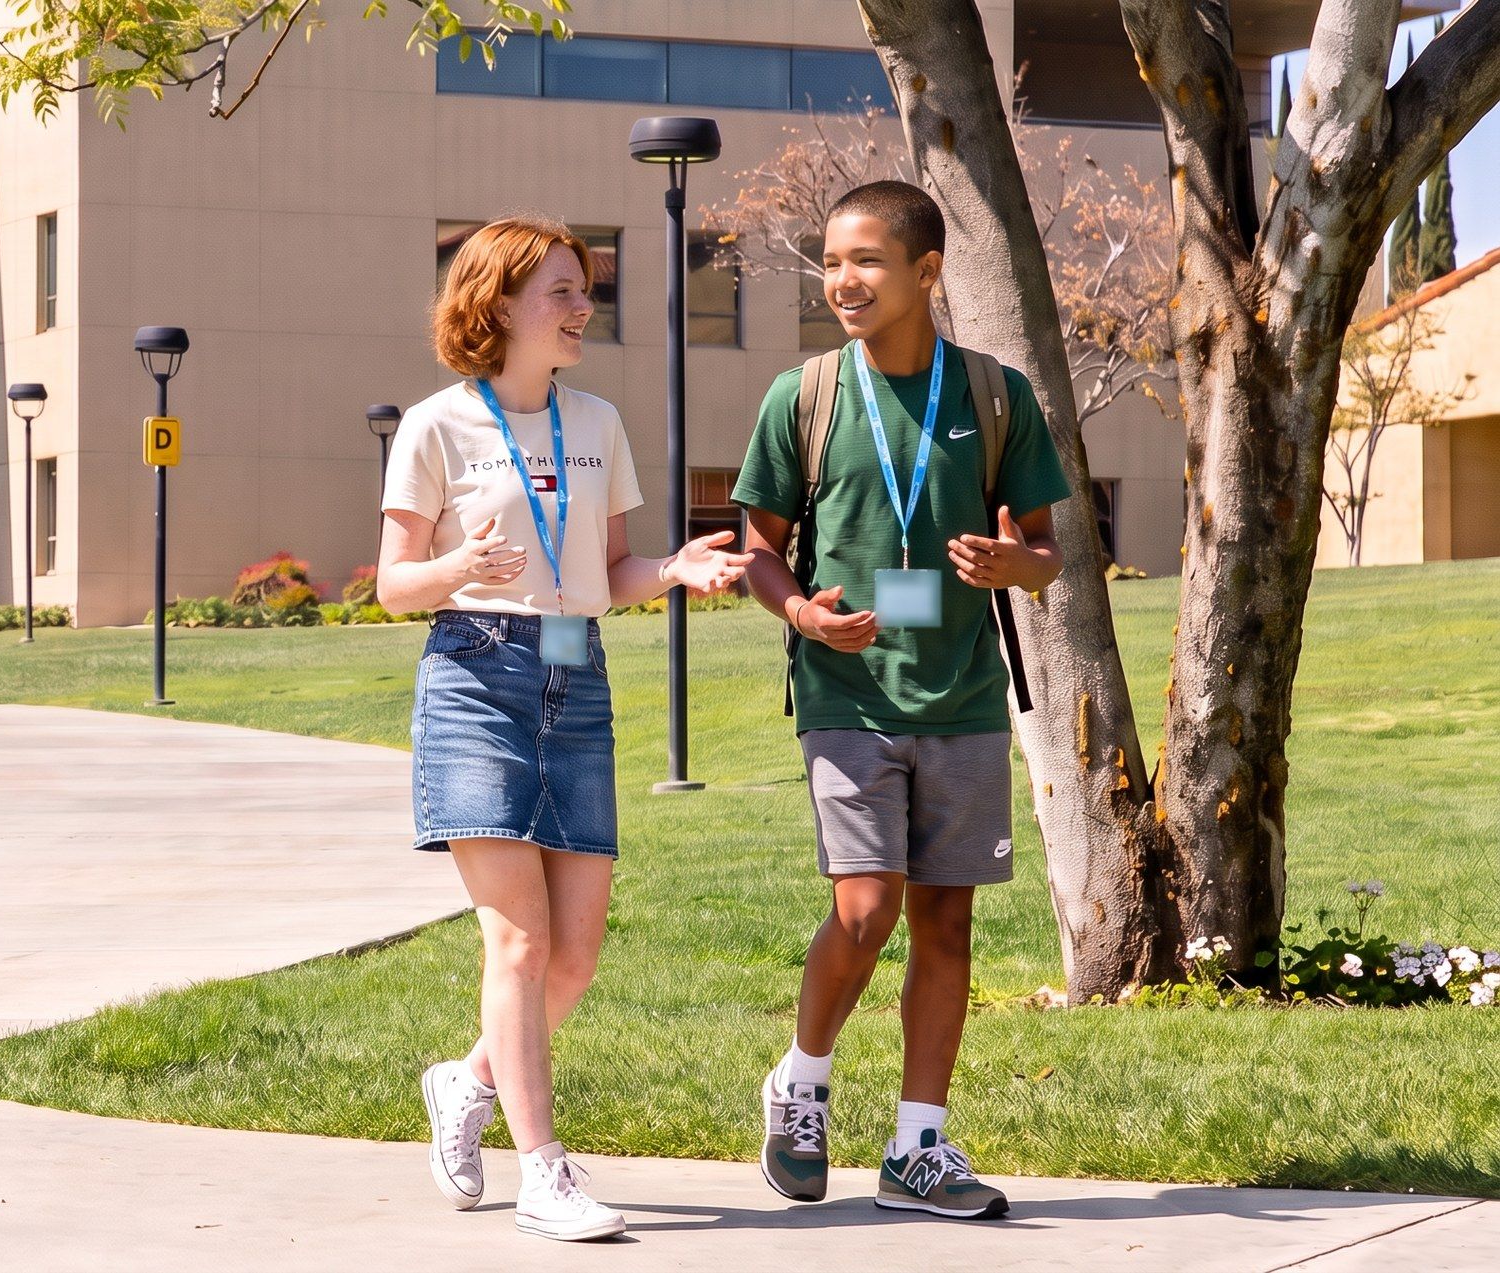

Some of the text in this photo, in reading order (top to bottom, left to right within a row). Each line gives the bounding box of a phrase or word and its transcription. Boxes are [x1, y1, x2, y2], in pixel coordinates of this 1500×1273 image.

[155, 428, 172, 449] D
[470, 456, 603, 472] TOMY HIFIGER
[906, 1161, 939, 1197] N
